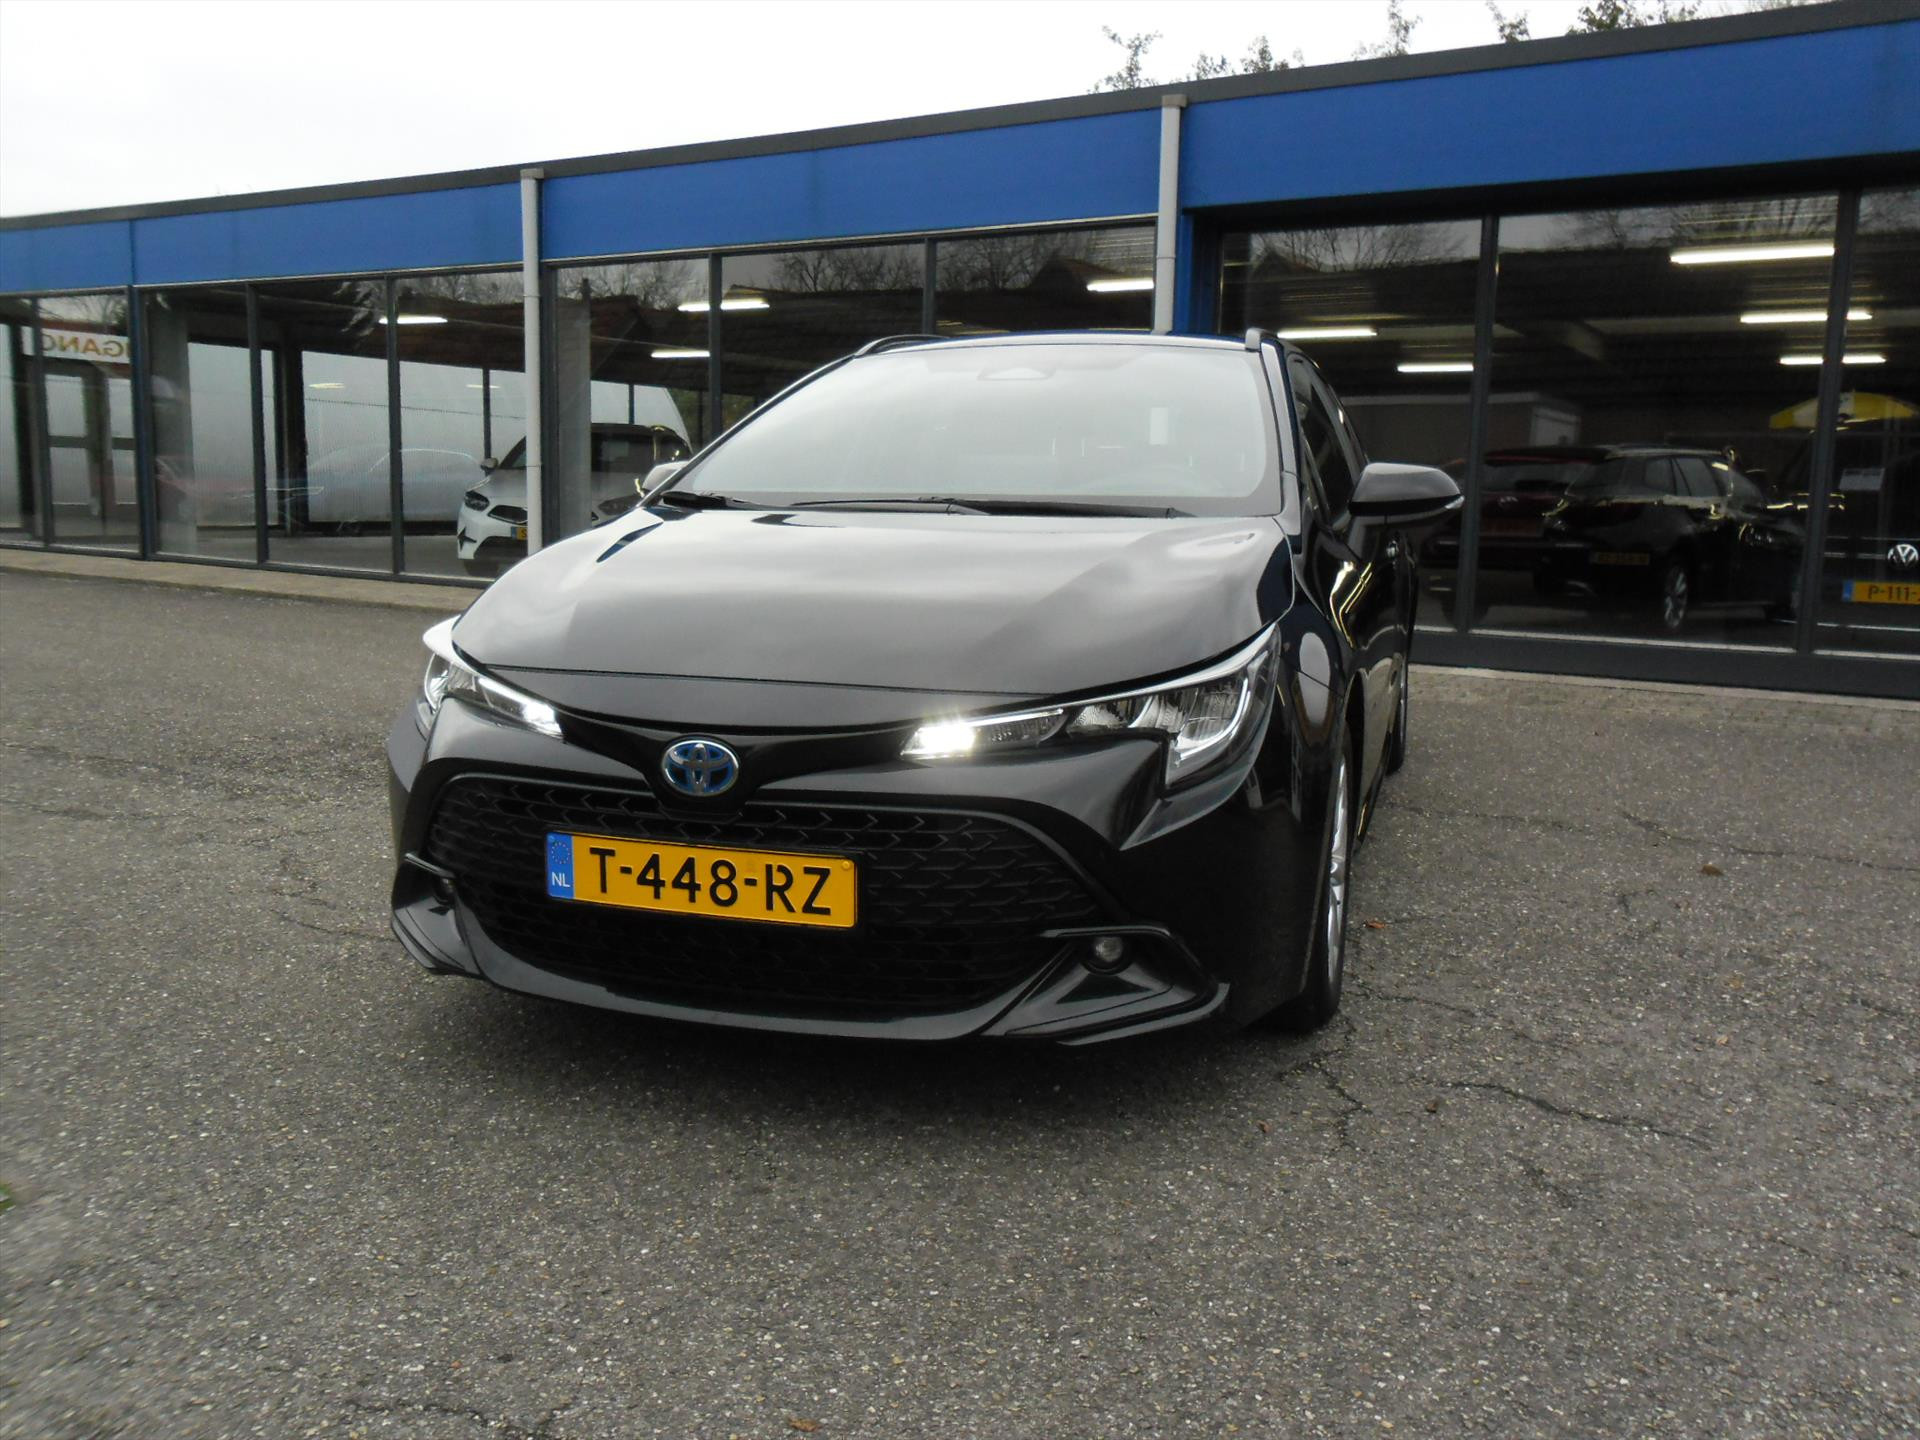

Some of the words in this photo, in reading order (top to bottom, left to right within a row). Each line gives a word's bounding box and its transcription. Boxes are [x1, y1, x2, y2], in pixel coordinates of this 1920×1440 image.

[1867, 584, 1920, 601] P-111-
[551, 872, 571, 888] NL
[589, 847, 831, 916] T-448-RZ
